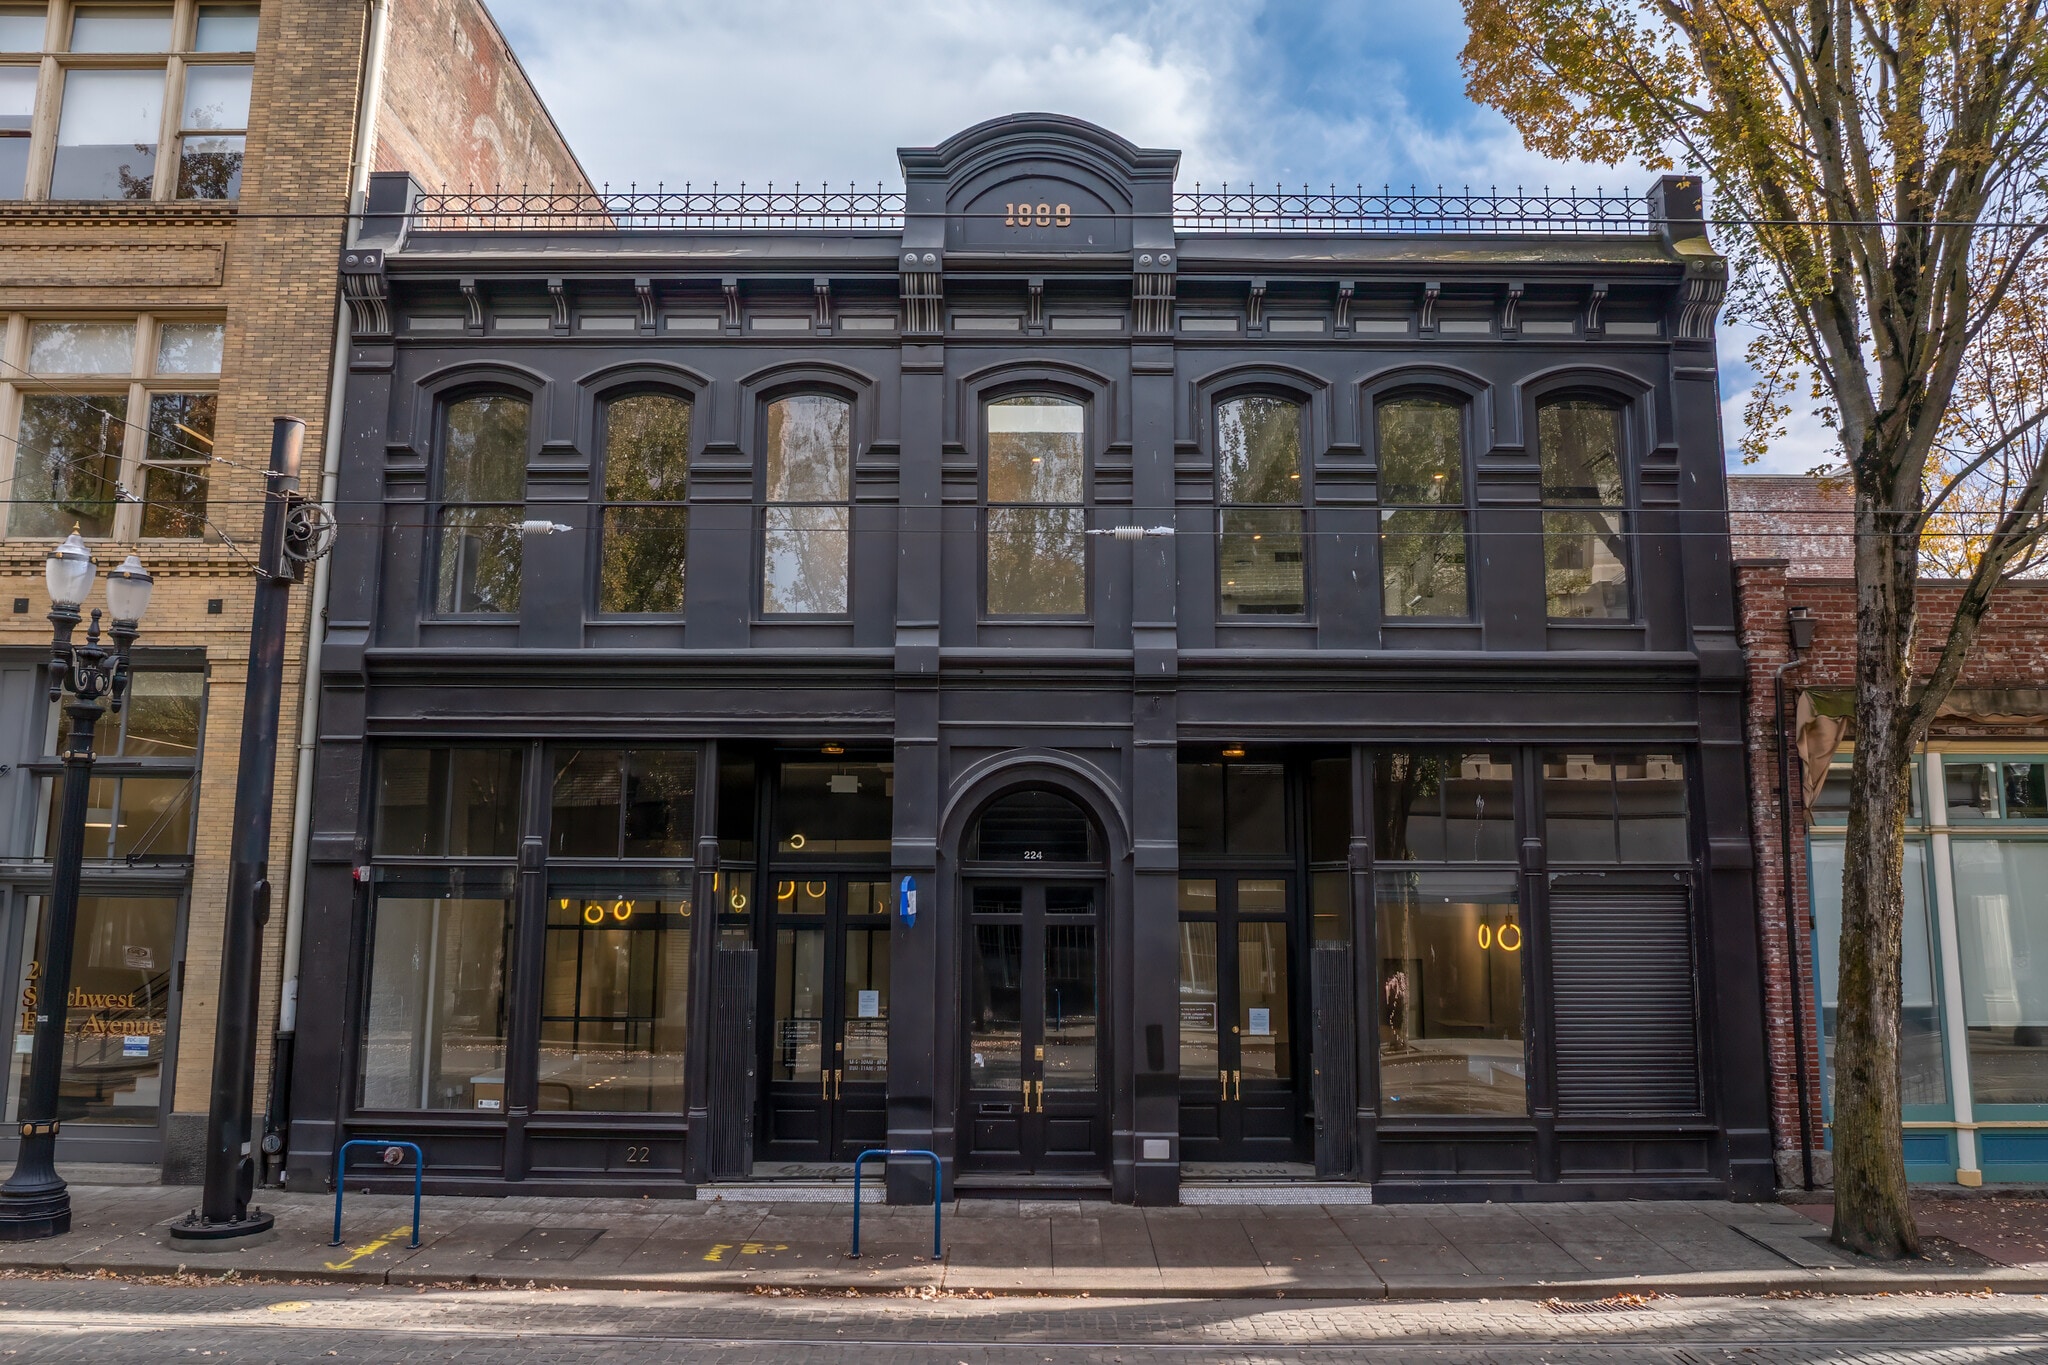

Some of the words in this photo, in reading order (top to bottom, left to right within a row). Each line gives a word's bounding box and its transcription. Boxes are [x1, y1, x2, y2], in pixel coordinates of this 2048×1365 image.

[1024, 850, 1043, 860] 224
[23, 986, 136, 1008] Sthwest
[82, 1013, 162, 1035] Avenue
[626, 1146, 650, 1163] 22
